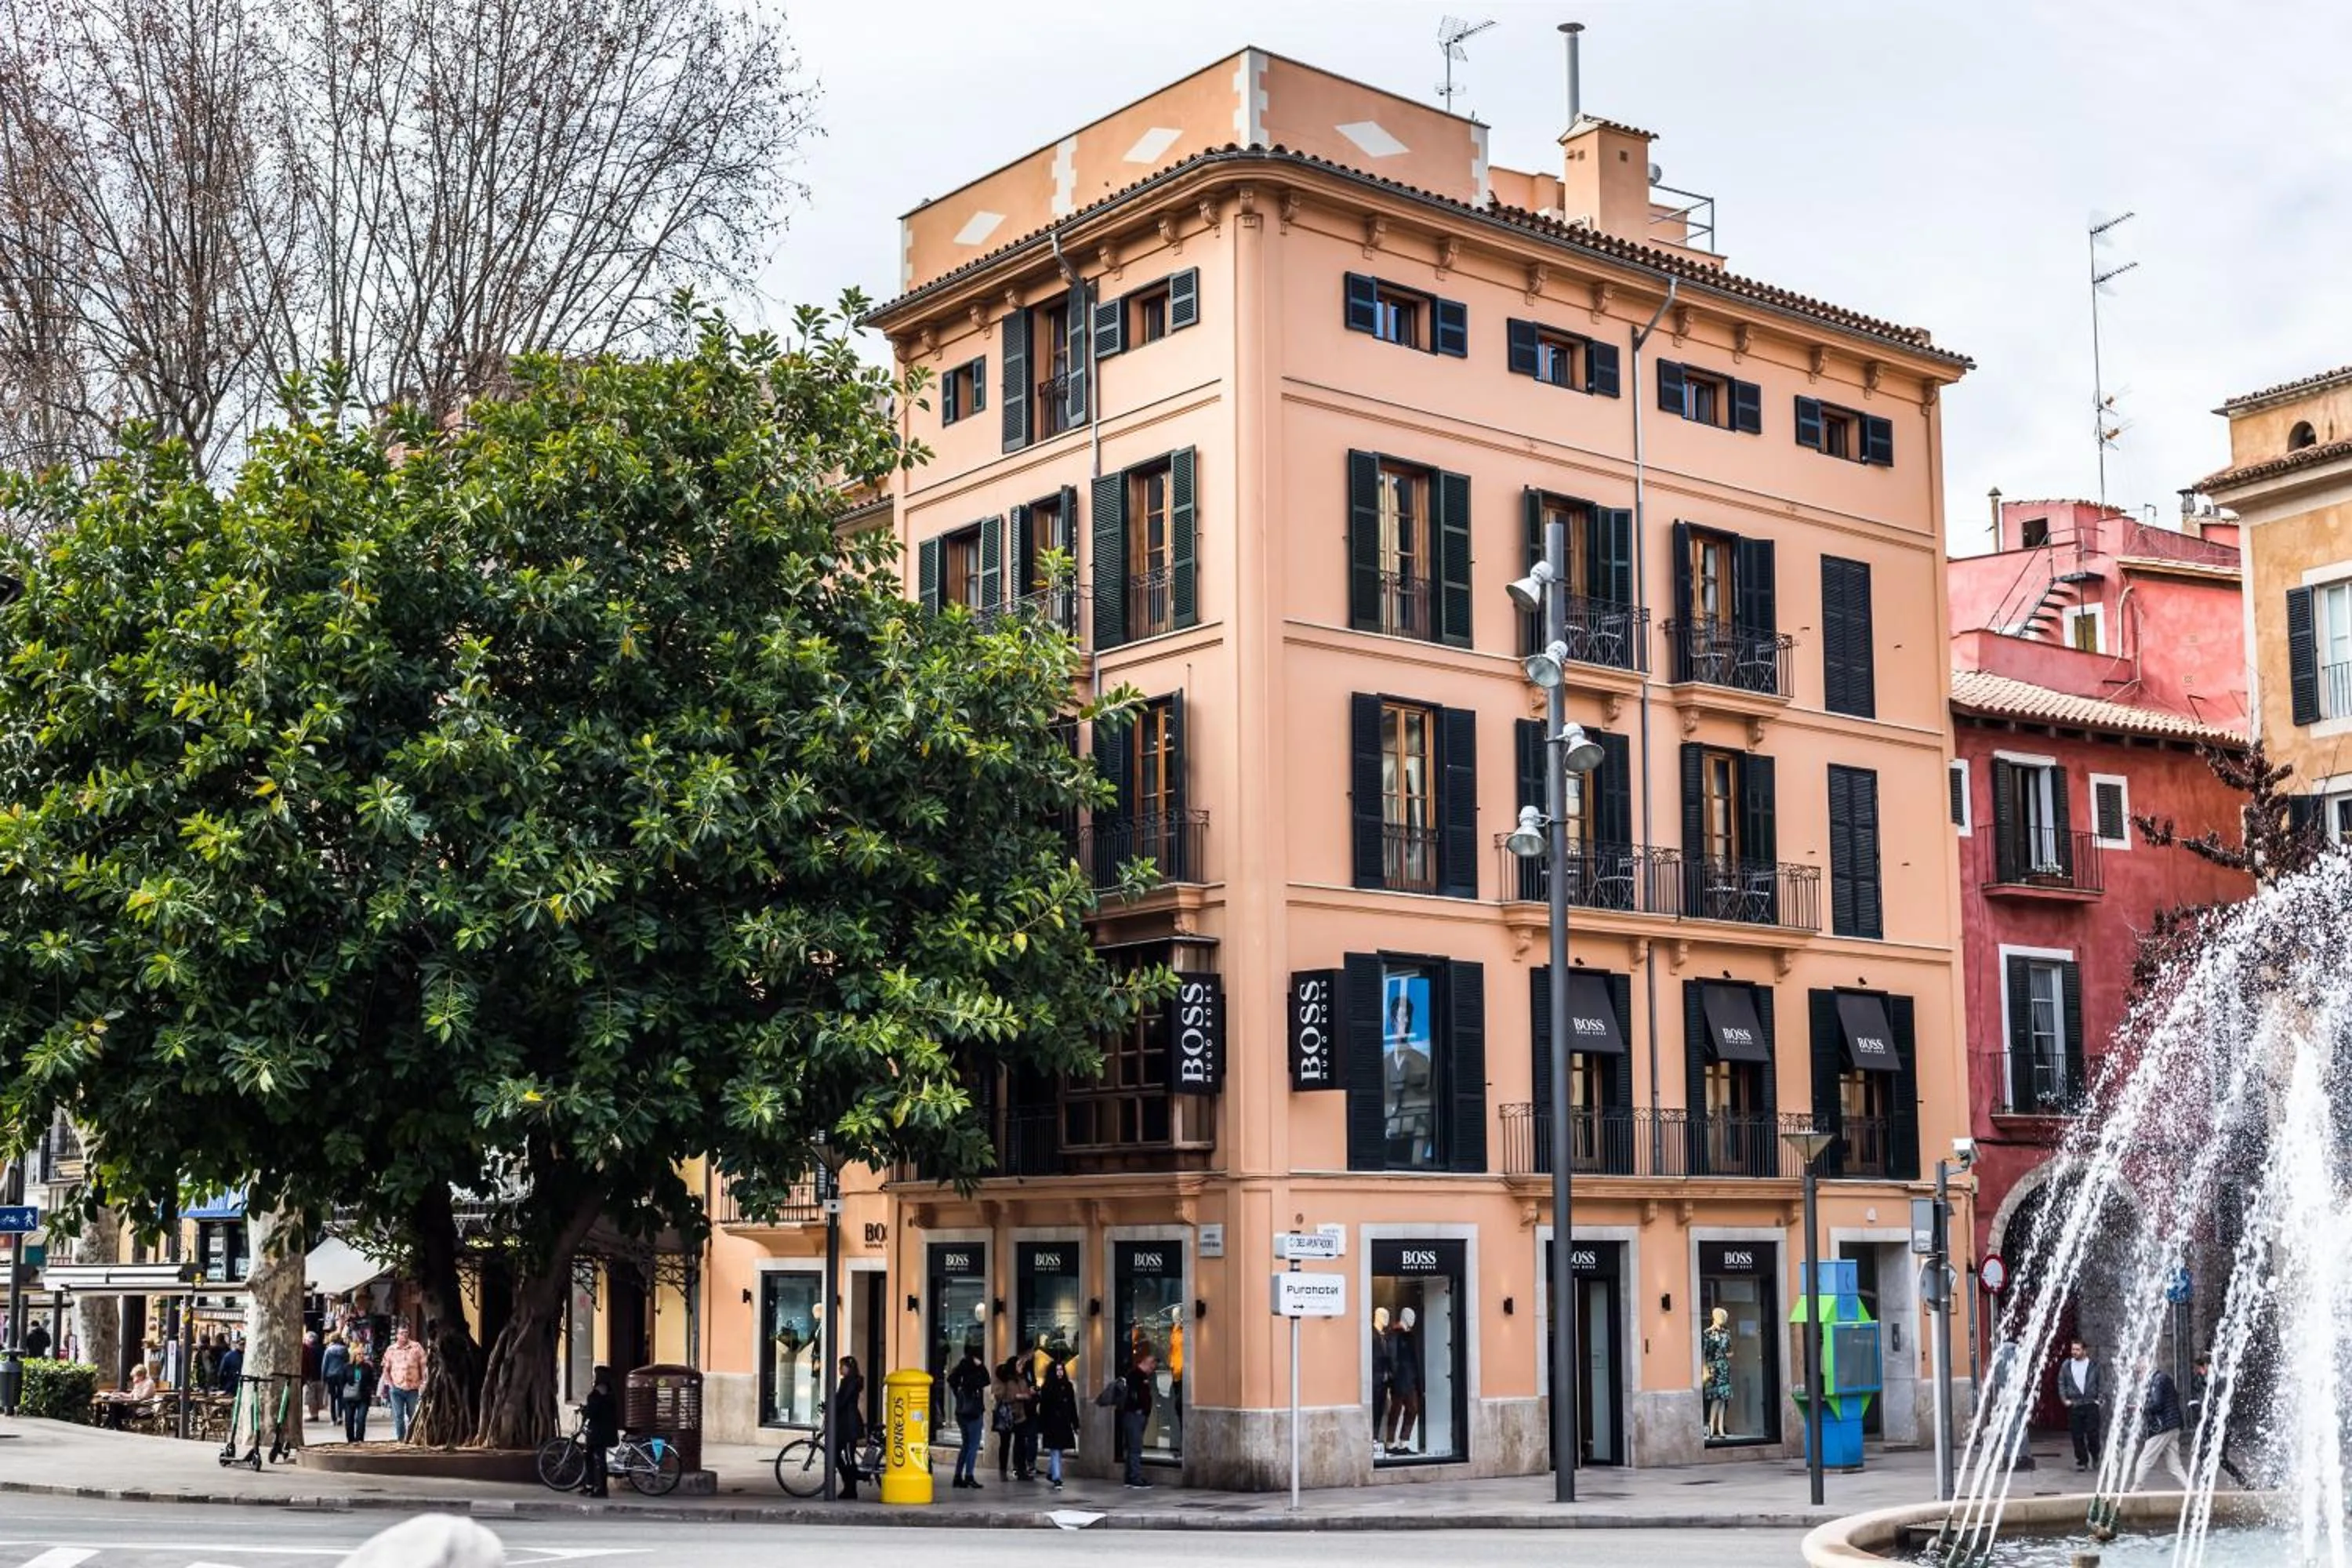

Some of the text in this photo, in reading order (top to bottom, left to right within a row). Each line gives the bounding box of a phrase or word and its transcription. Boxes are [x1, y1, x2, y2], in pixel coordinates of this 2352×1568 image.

[1299, 980, 1321, 1081] BOSS
[1573, 1018, 1606, 1032] BOSS
[1181, 983, 1204, 1082] BOSS
[1722, 1028, 1752, 1040] BOSS
[1857, 1037, 1884, 1050] BOSS
[865, 1222, 887, 1242] BO
[946, 1254, 969, 1266] BOSS
[1036, 1253, 1061, 1266] BOSS
[1134, 1253, 1162, 1267] BOSS
[1402, 1250, 1436, 1265] BOSS
[1724, 1251, 1752, 1265] BOSS
[892, 1396, 905, 1468] CORREOS
